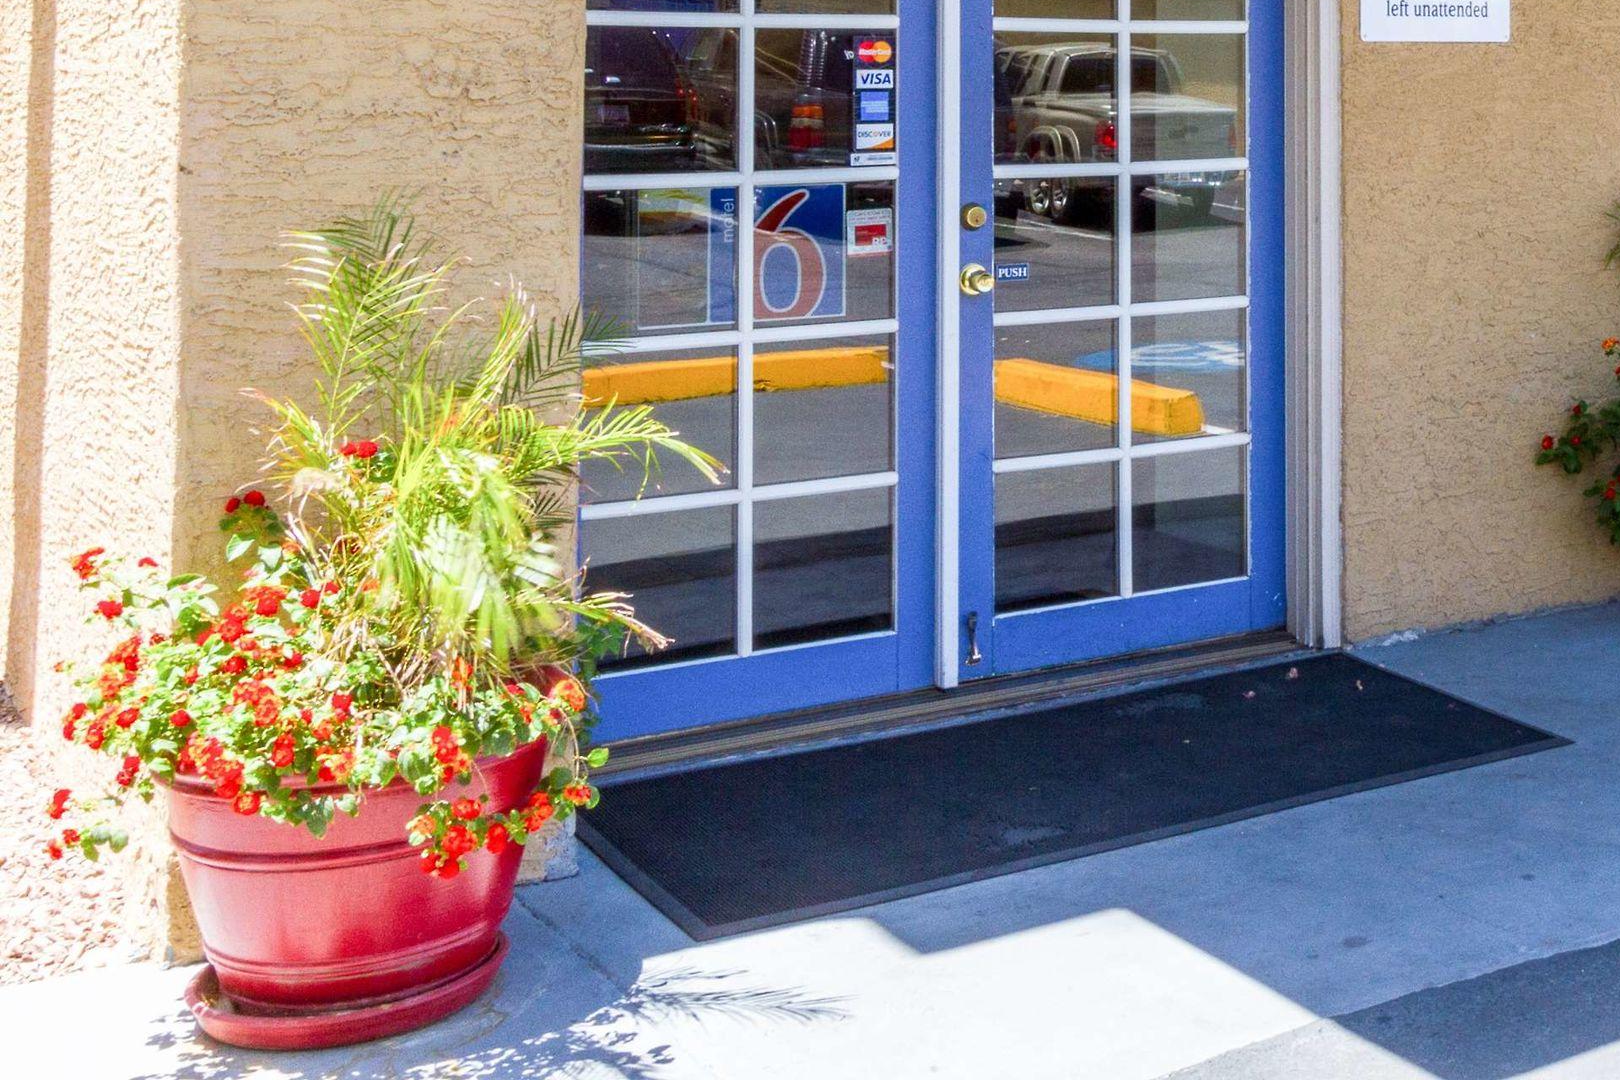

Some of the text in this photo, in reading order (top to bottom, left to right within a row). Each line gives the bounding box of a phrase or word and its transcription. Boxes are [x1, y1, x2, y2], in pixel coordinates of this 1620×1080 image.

[1386, 0, 1489, 18] left unattended
[861, 72, 892, 85] VISA
[720, 198, 738, 243] motel
[735, 188, 827, 321] 6
[998, 266, 1027, 278] PUSH
